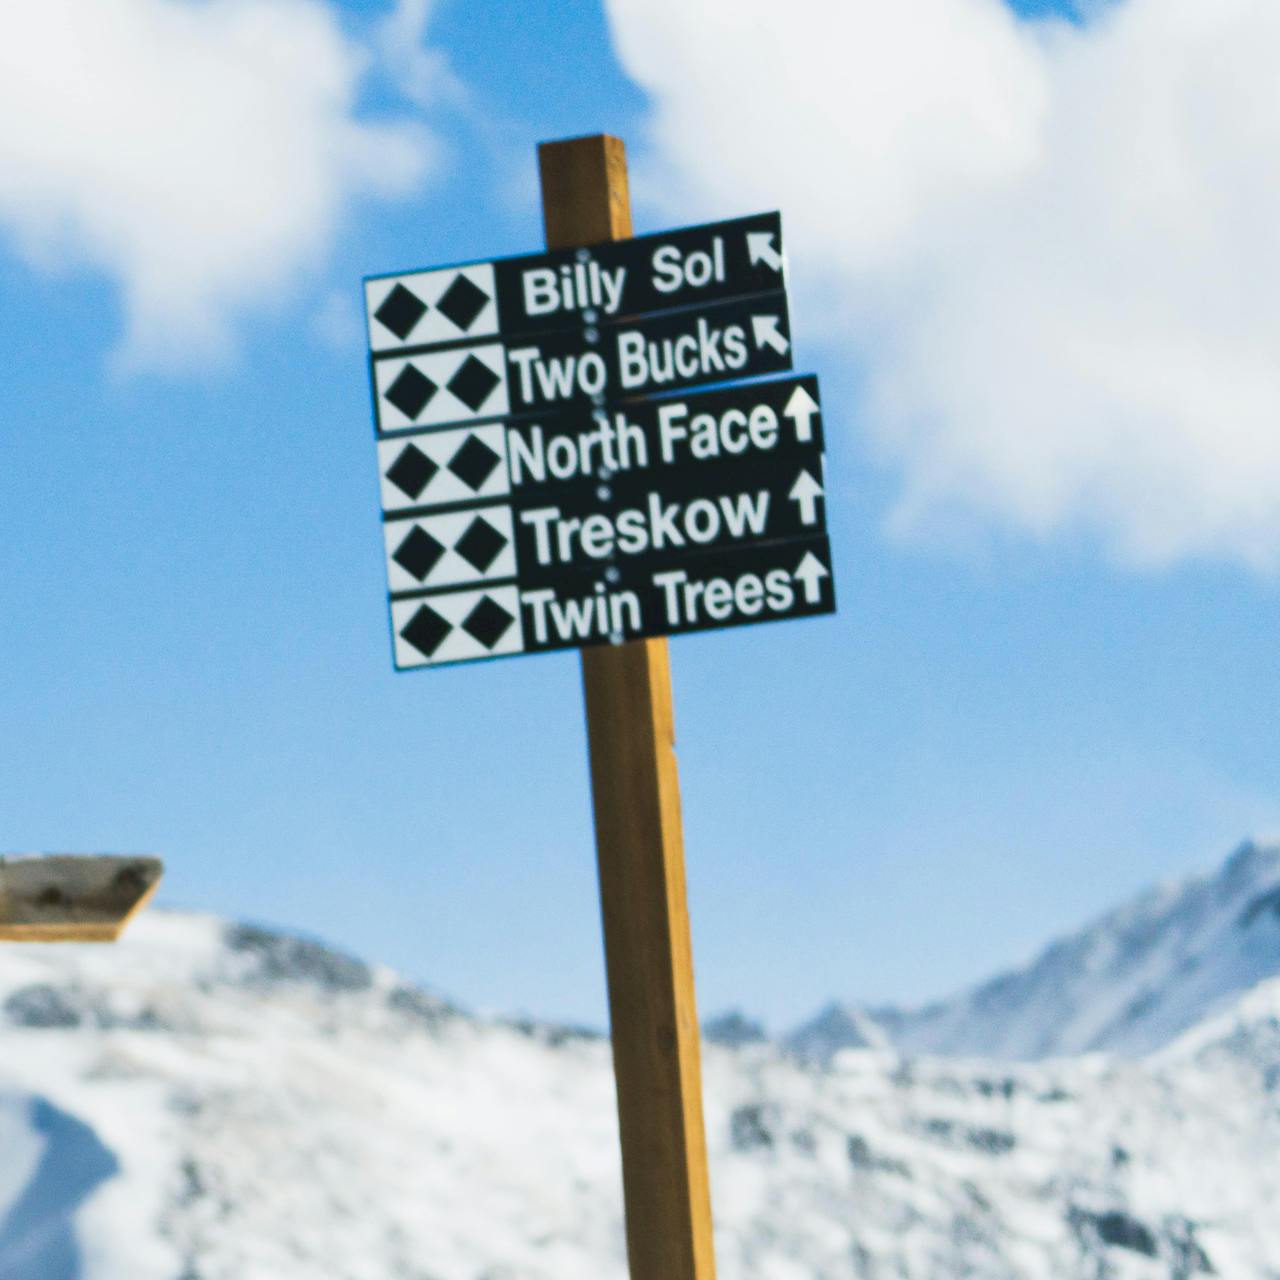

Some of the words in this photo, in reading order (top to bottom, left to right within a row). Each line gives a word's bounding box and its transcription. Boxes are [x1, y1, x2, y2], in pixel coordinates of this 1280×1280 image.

[522, 260, 627, 316] Billy
[652, 236, 726, 293] Sol
[509, 348, 606, 404] Two
[618, 319, 748, 390] Bucks
[508, 413, 648, 486] North
[658, 403, 779, 465] Face
[521, 492, 770, 566] Treskow
[522, 581, 641, 645] Twin
[653, 568, 795, 628] Trees
